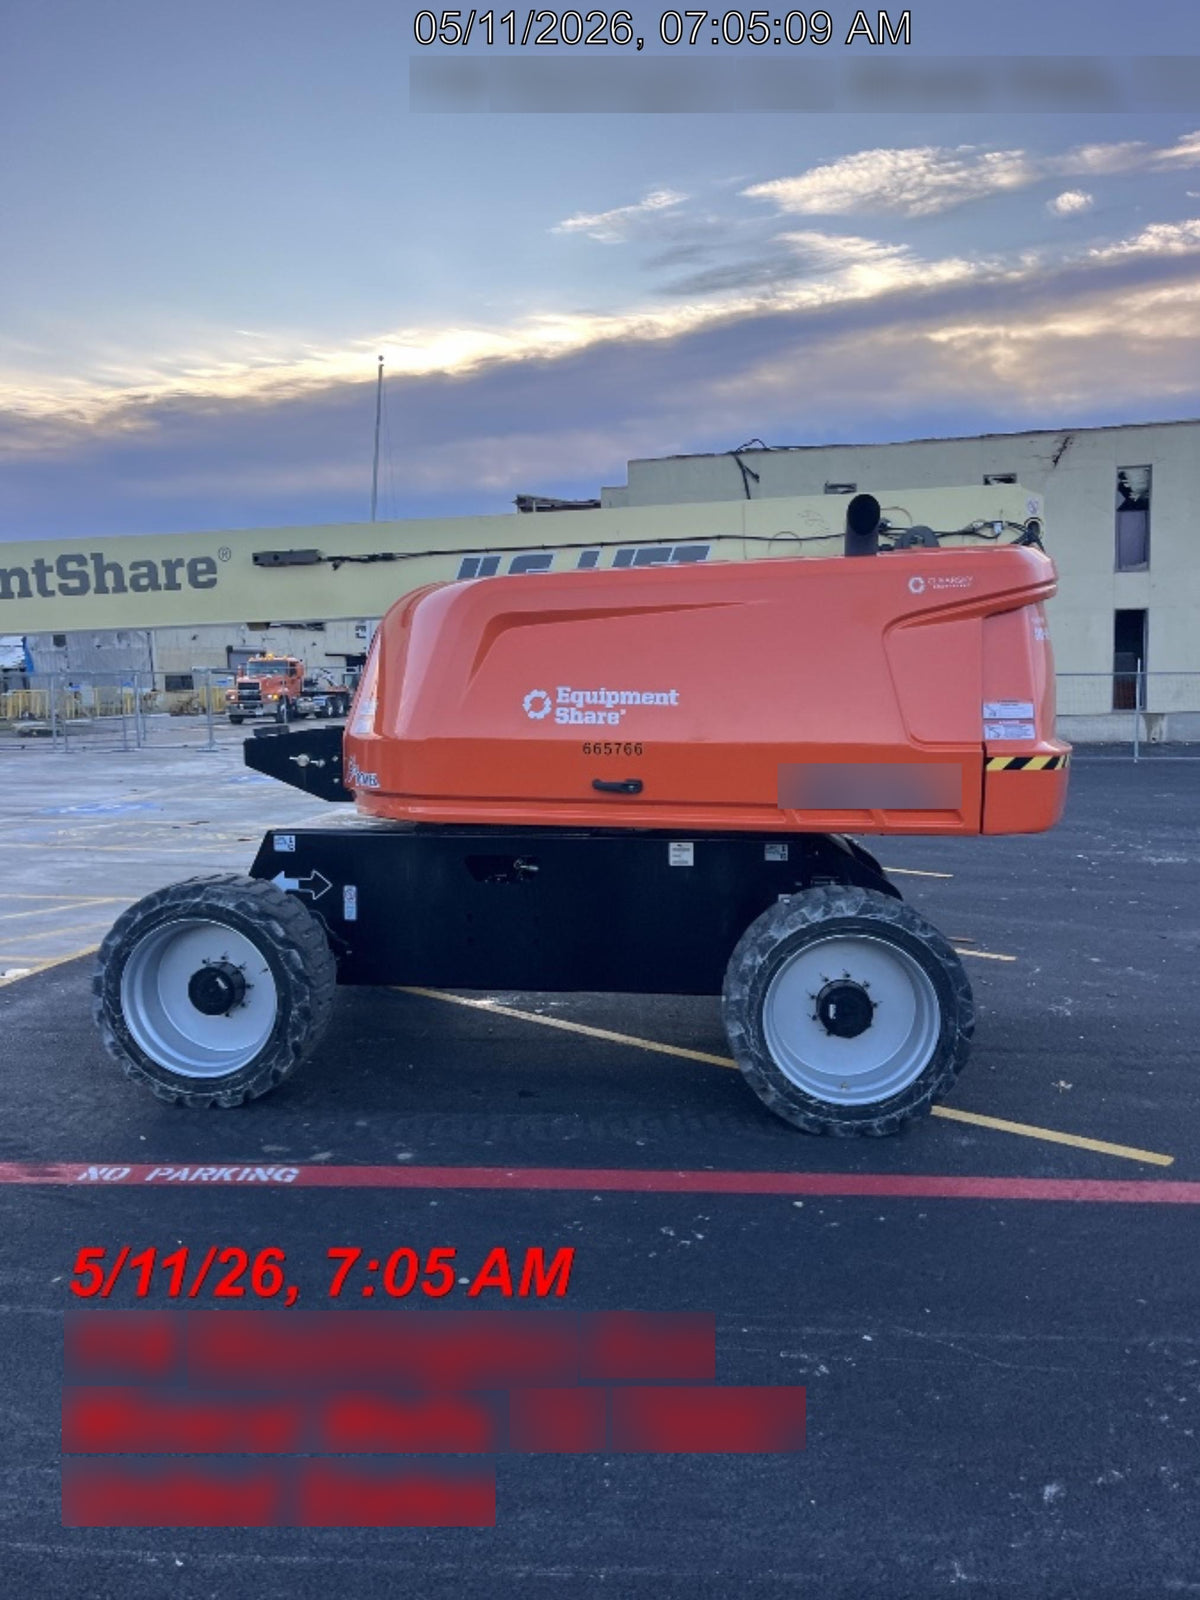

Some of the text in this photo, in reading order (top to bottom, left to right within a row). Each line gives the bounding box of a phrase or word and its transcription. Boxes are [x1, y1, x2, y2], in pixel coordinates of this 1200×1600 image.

[556, 686, 680, 708] Equipment
[582, 742, 643, 756] 665766
[77, 1166, 300, 1183] NO PARKING
